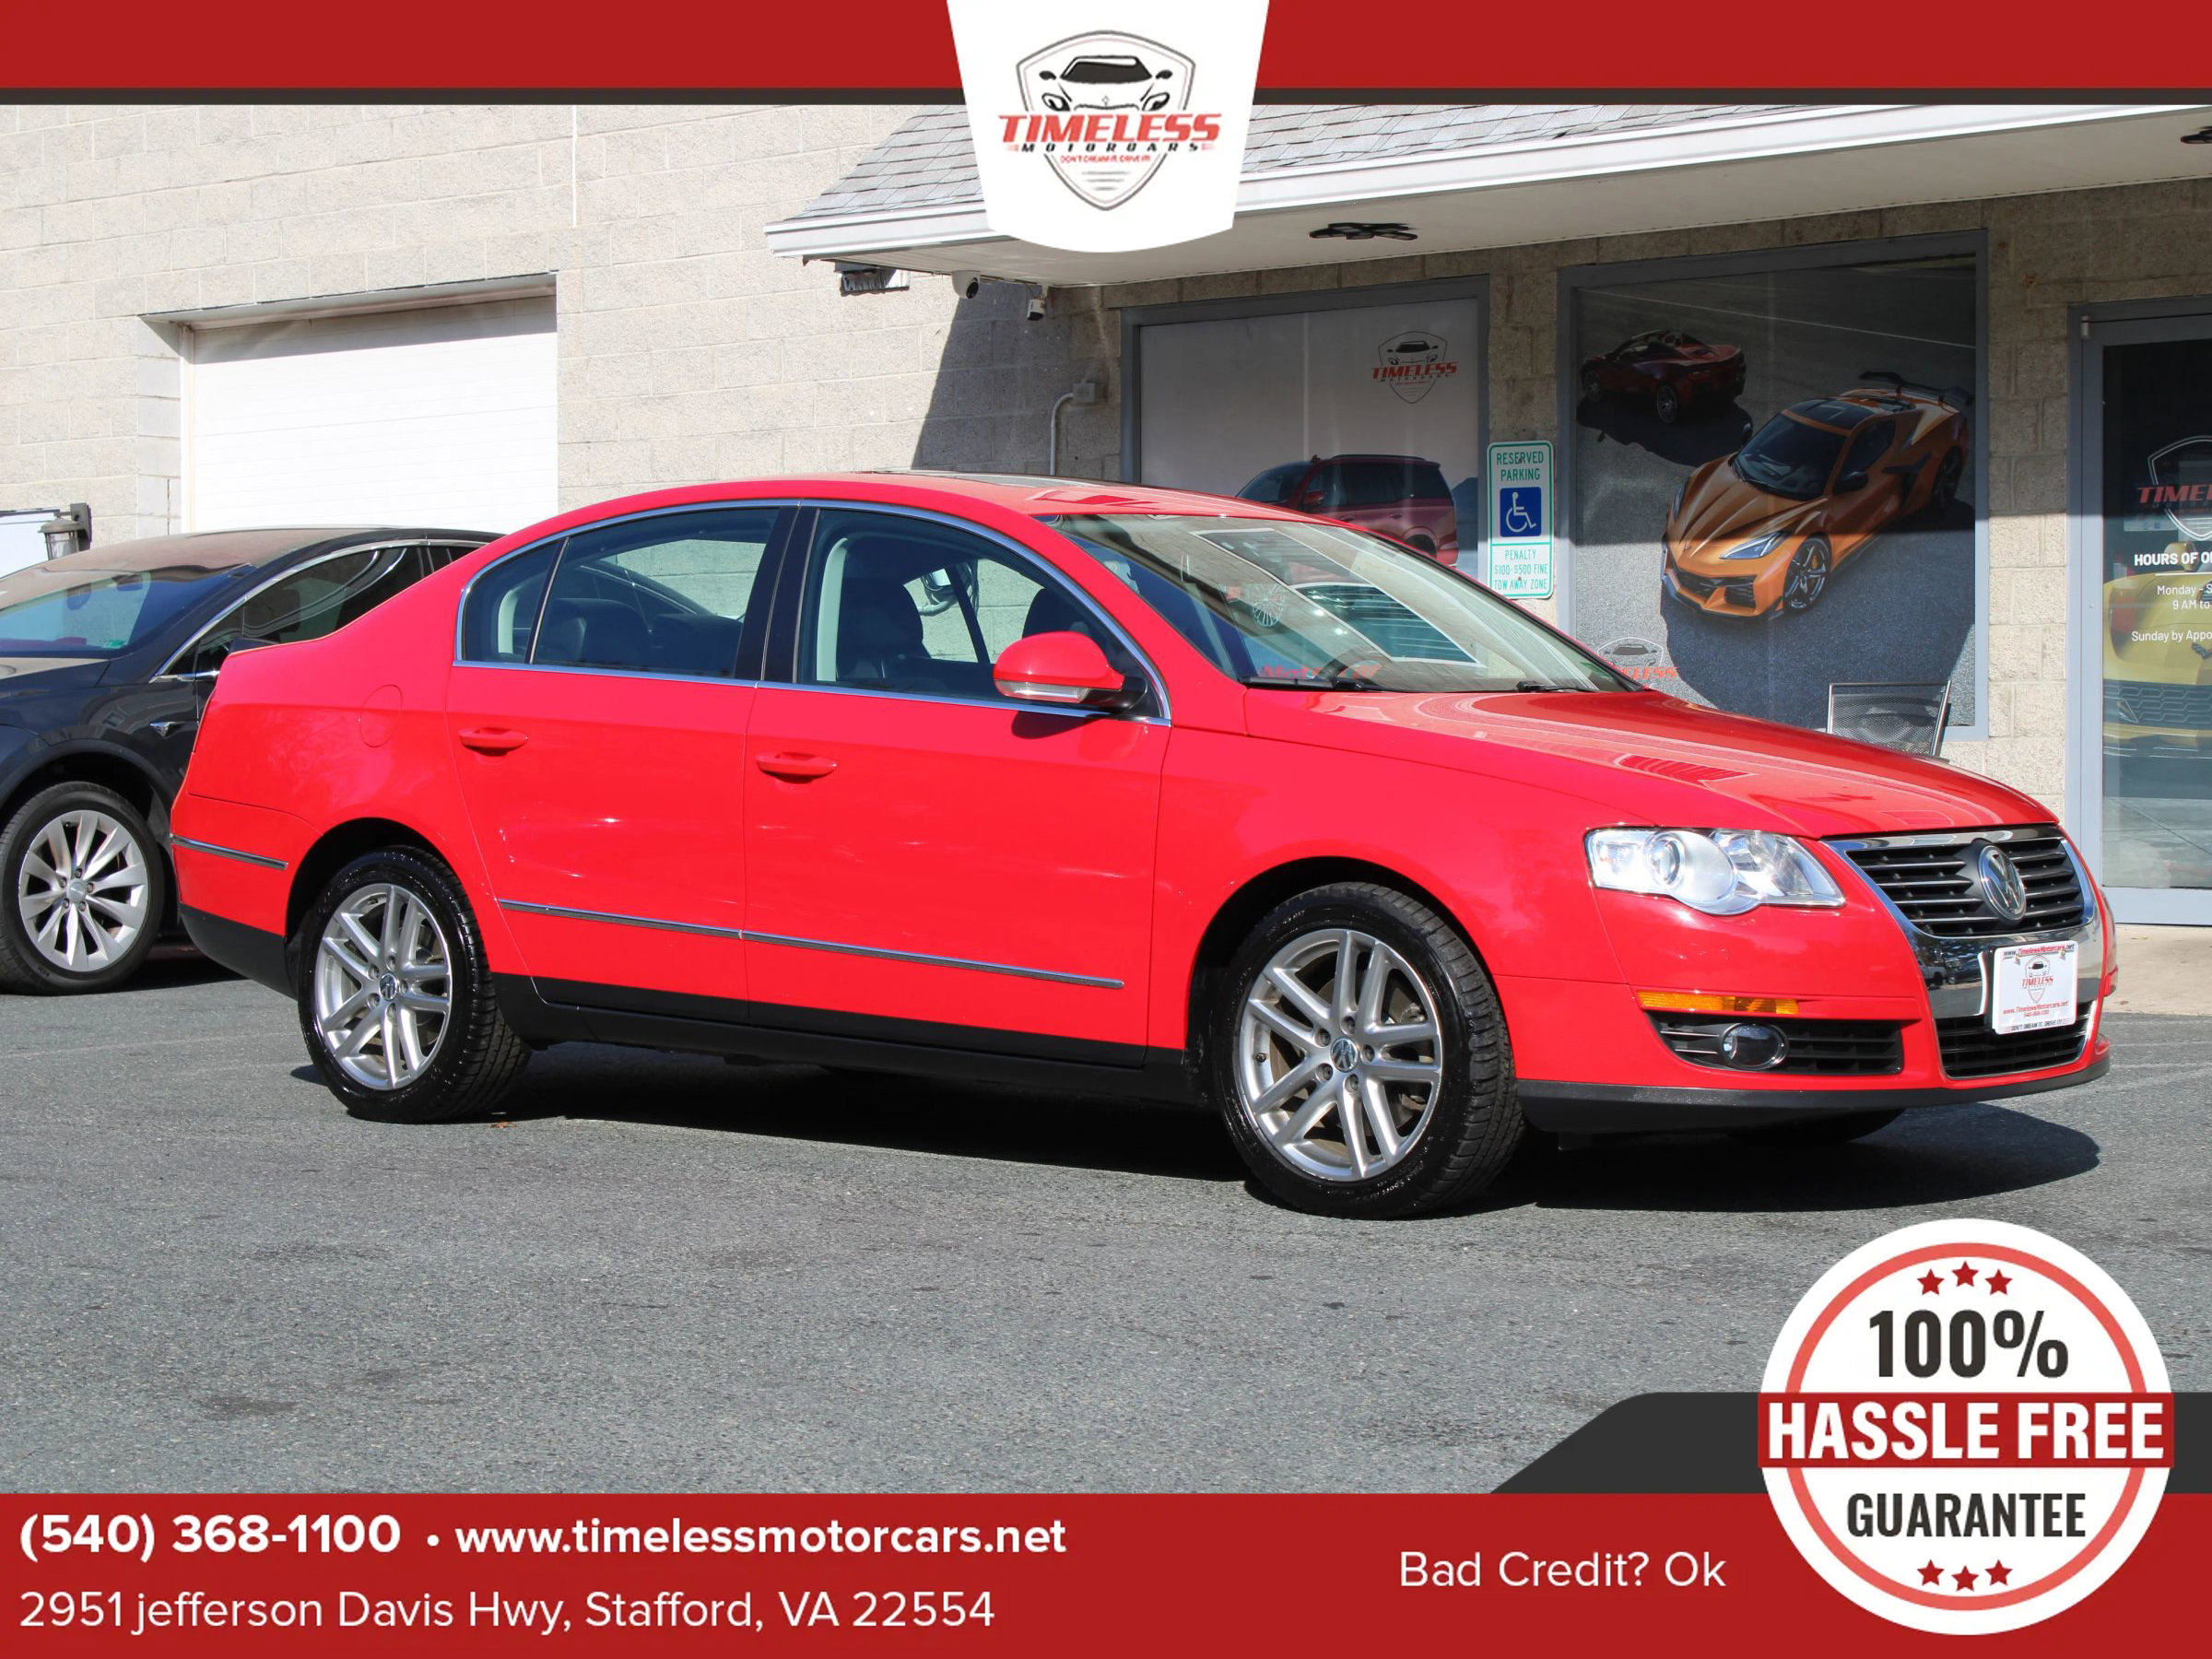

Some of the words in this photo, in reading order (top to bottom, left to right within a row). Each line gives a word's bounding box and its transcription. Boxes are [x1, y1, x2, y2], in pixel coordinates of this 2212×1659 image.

[1372, 361, 1459, 379] TIMELESS
[1496, 451, 1544, 465] RESERVED
[1500, 468, 1540, 481] PARKING
[1504, 549, 1536, 560] PENALTY
[2134, 553, 2178, 566] HOURS
[2181, 552, 2198, 564] OF
[1534, 563, 1548, 574] FINE
[1493, 579, 1508, 590] TOW
[1510, 579, 1527, 590] AWAY
[1531, 578, 1547, 590] ZONE
[2157, 584, 2196, 597] Monday
[2172, 599, 2179, 610] 9
[2181, 599, 2197, 610] AM
[2199, 600, 2210, 609] to
[2131, 630, 2169, 643] Sunday
[2171, 629, 2183, 642] by
[2022, 977, 2053, 987] TIMELESS
